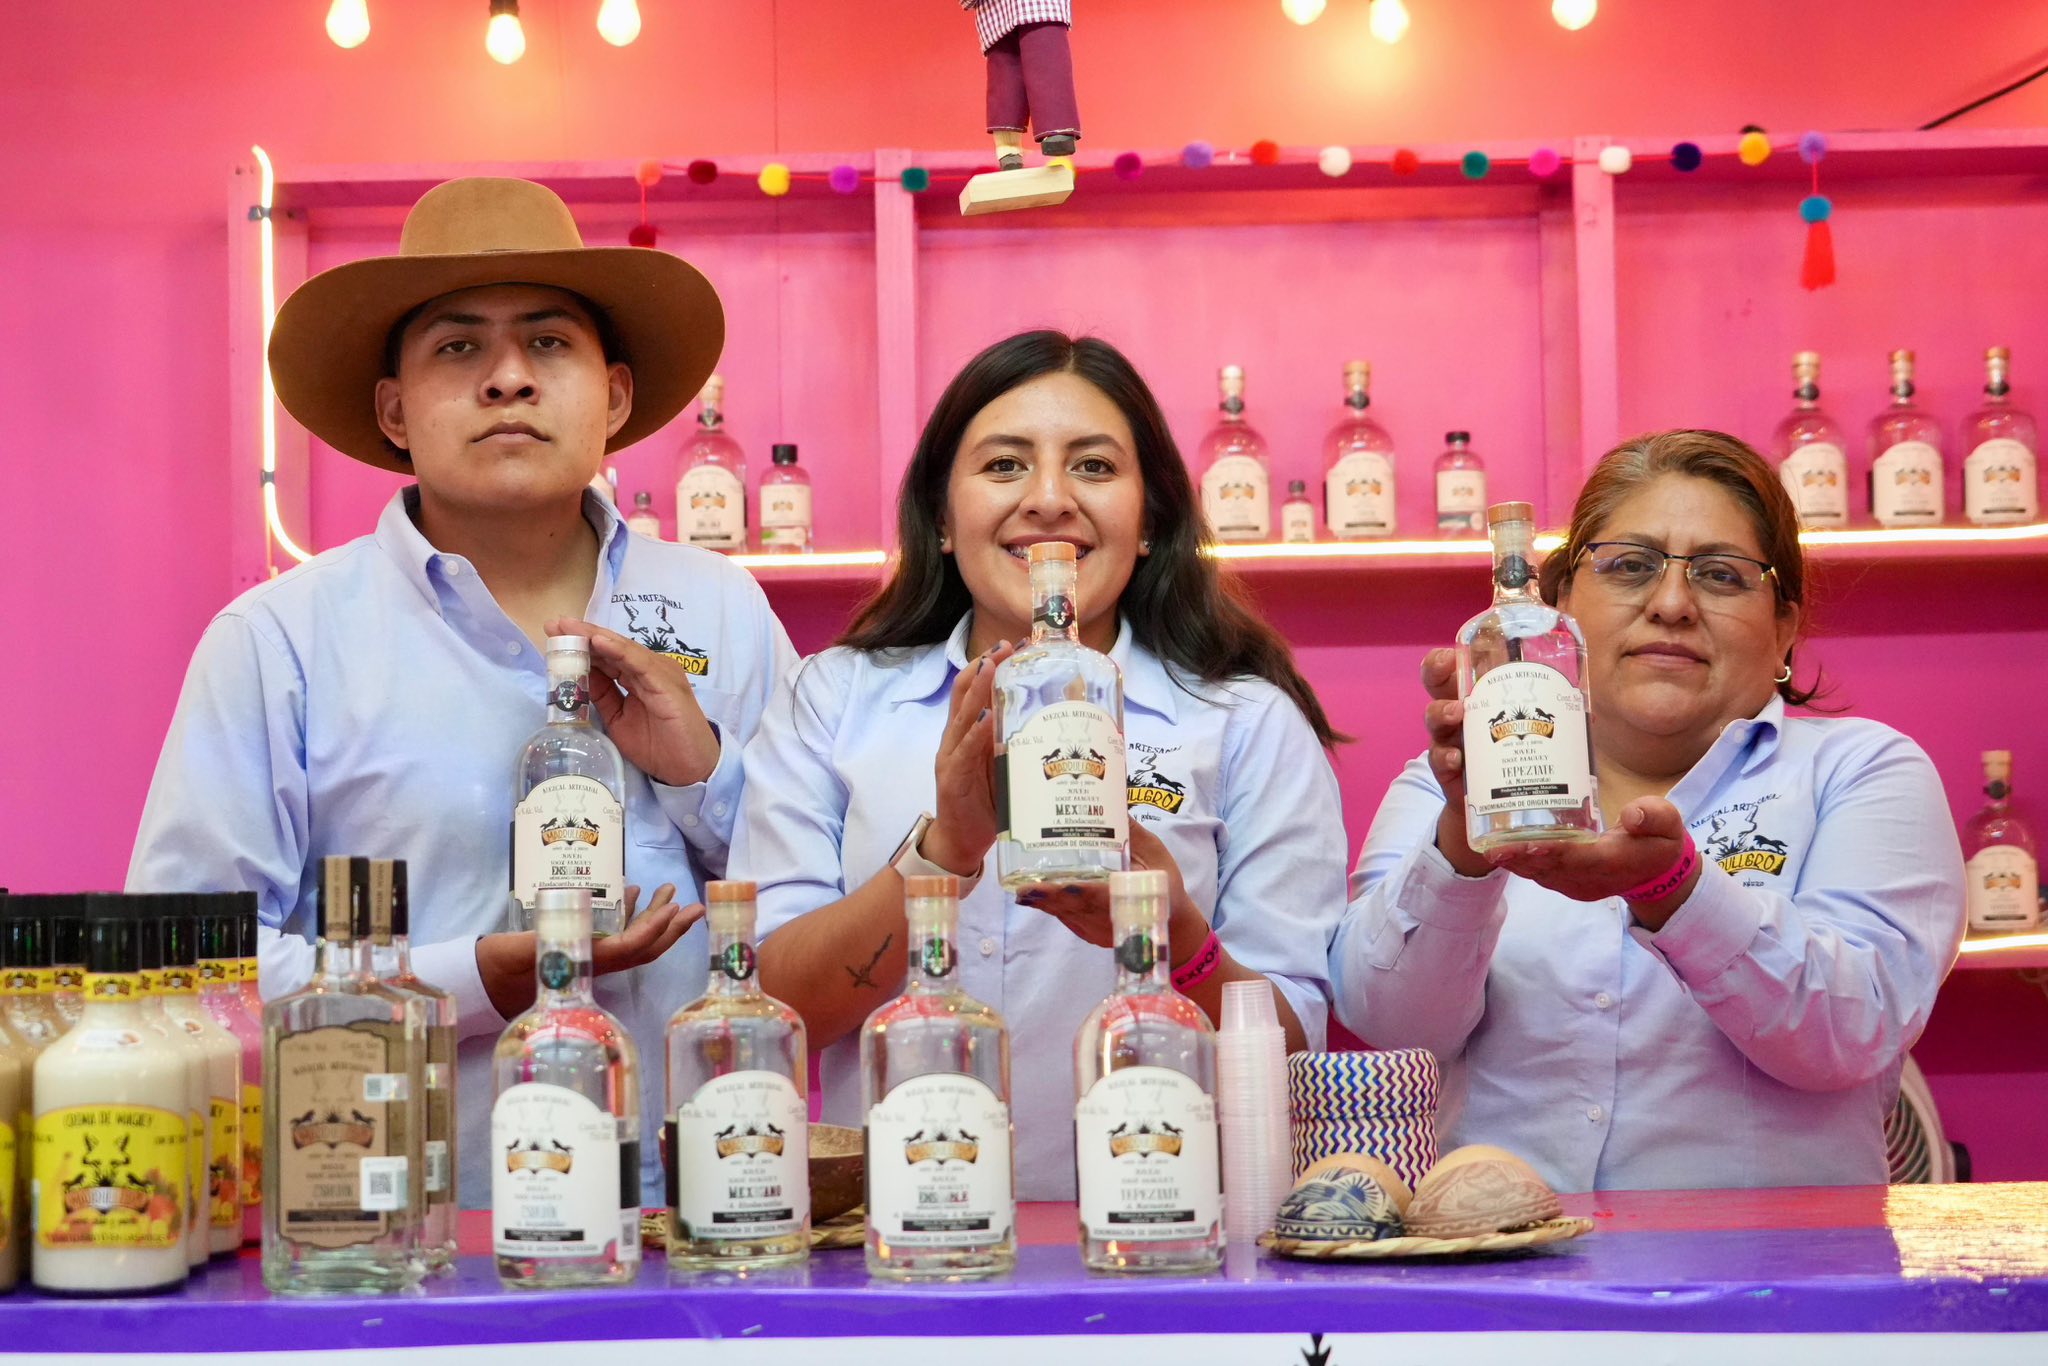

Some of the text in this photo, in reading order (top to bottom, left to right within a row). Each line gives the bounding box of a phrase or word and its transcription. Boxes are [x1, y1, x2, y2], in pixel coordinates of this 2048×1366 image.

[611, 593, 684, 610] EZCAL ARTESANAL
[1487, 671, 1550, 685] MEZCAL ARTESANAL
[1042, 710, 1103, 723] MEZCAL ARTESANAL
[1502, 764, 1555, 778] TEPEZTATE
[542, 783, 599, 795] MEZCAL ARTESANAL
[1055, 804, 1104, 816] MEXICANO
[1479, 800, 1518, 812] DENOMINACIÓN
[1526, 798, 1549, 806] ORIGEN
[1549, 797, 1579, 806] PROTEGIDA
[1690, 806, 1729, 829] MEZCAL
[1026, 840, 1069, 850] DENOMINACIÓN
[1078, 840, 1099, 848] ORIGEN
[729, 1185, 782, 1199] MEXICANO
